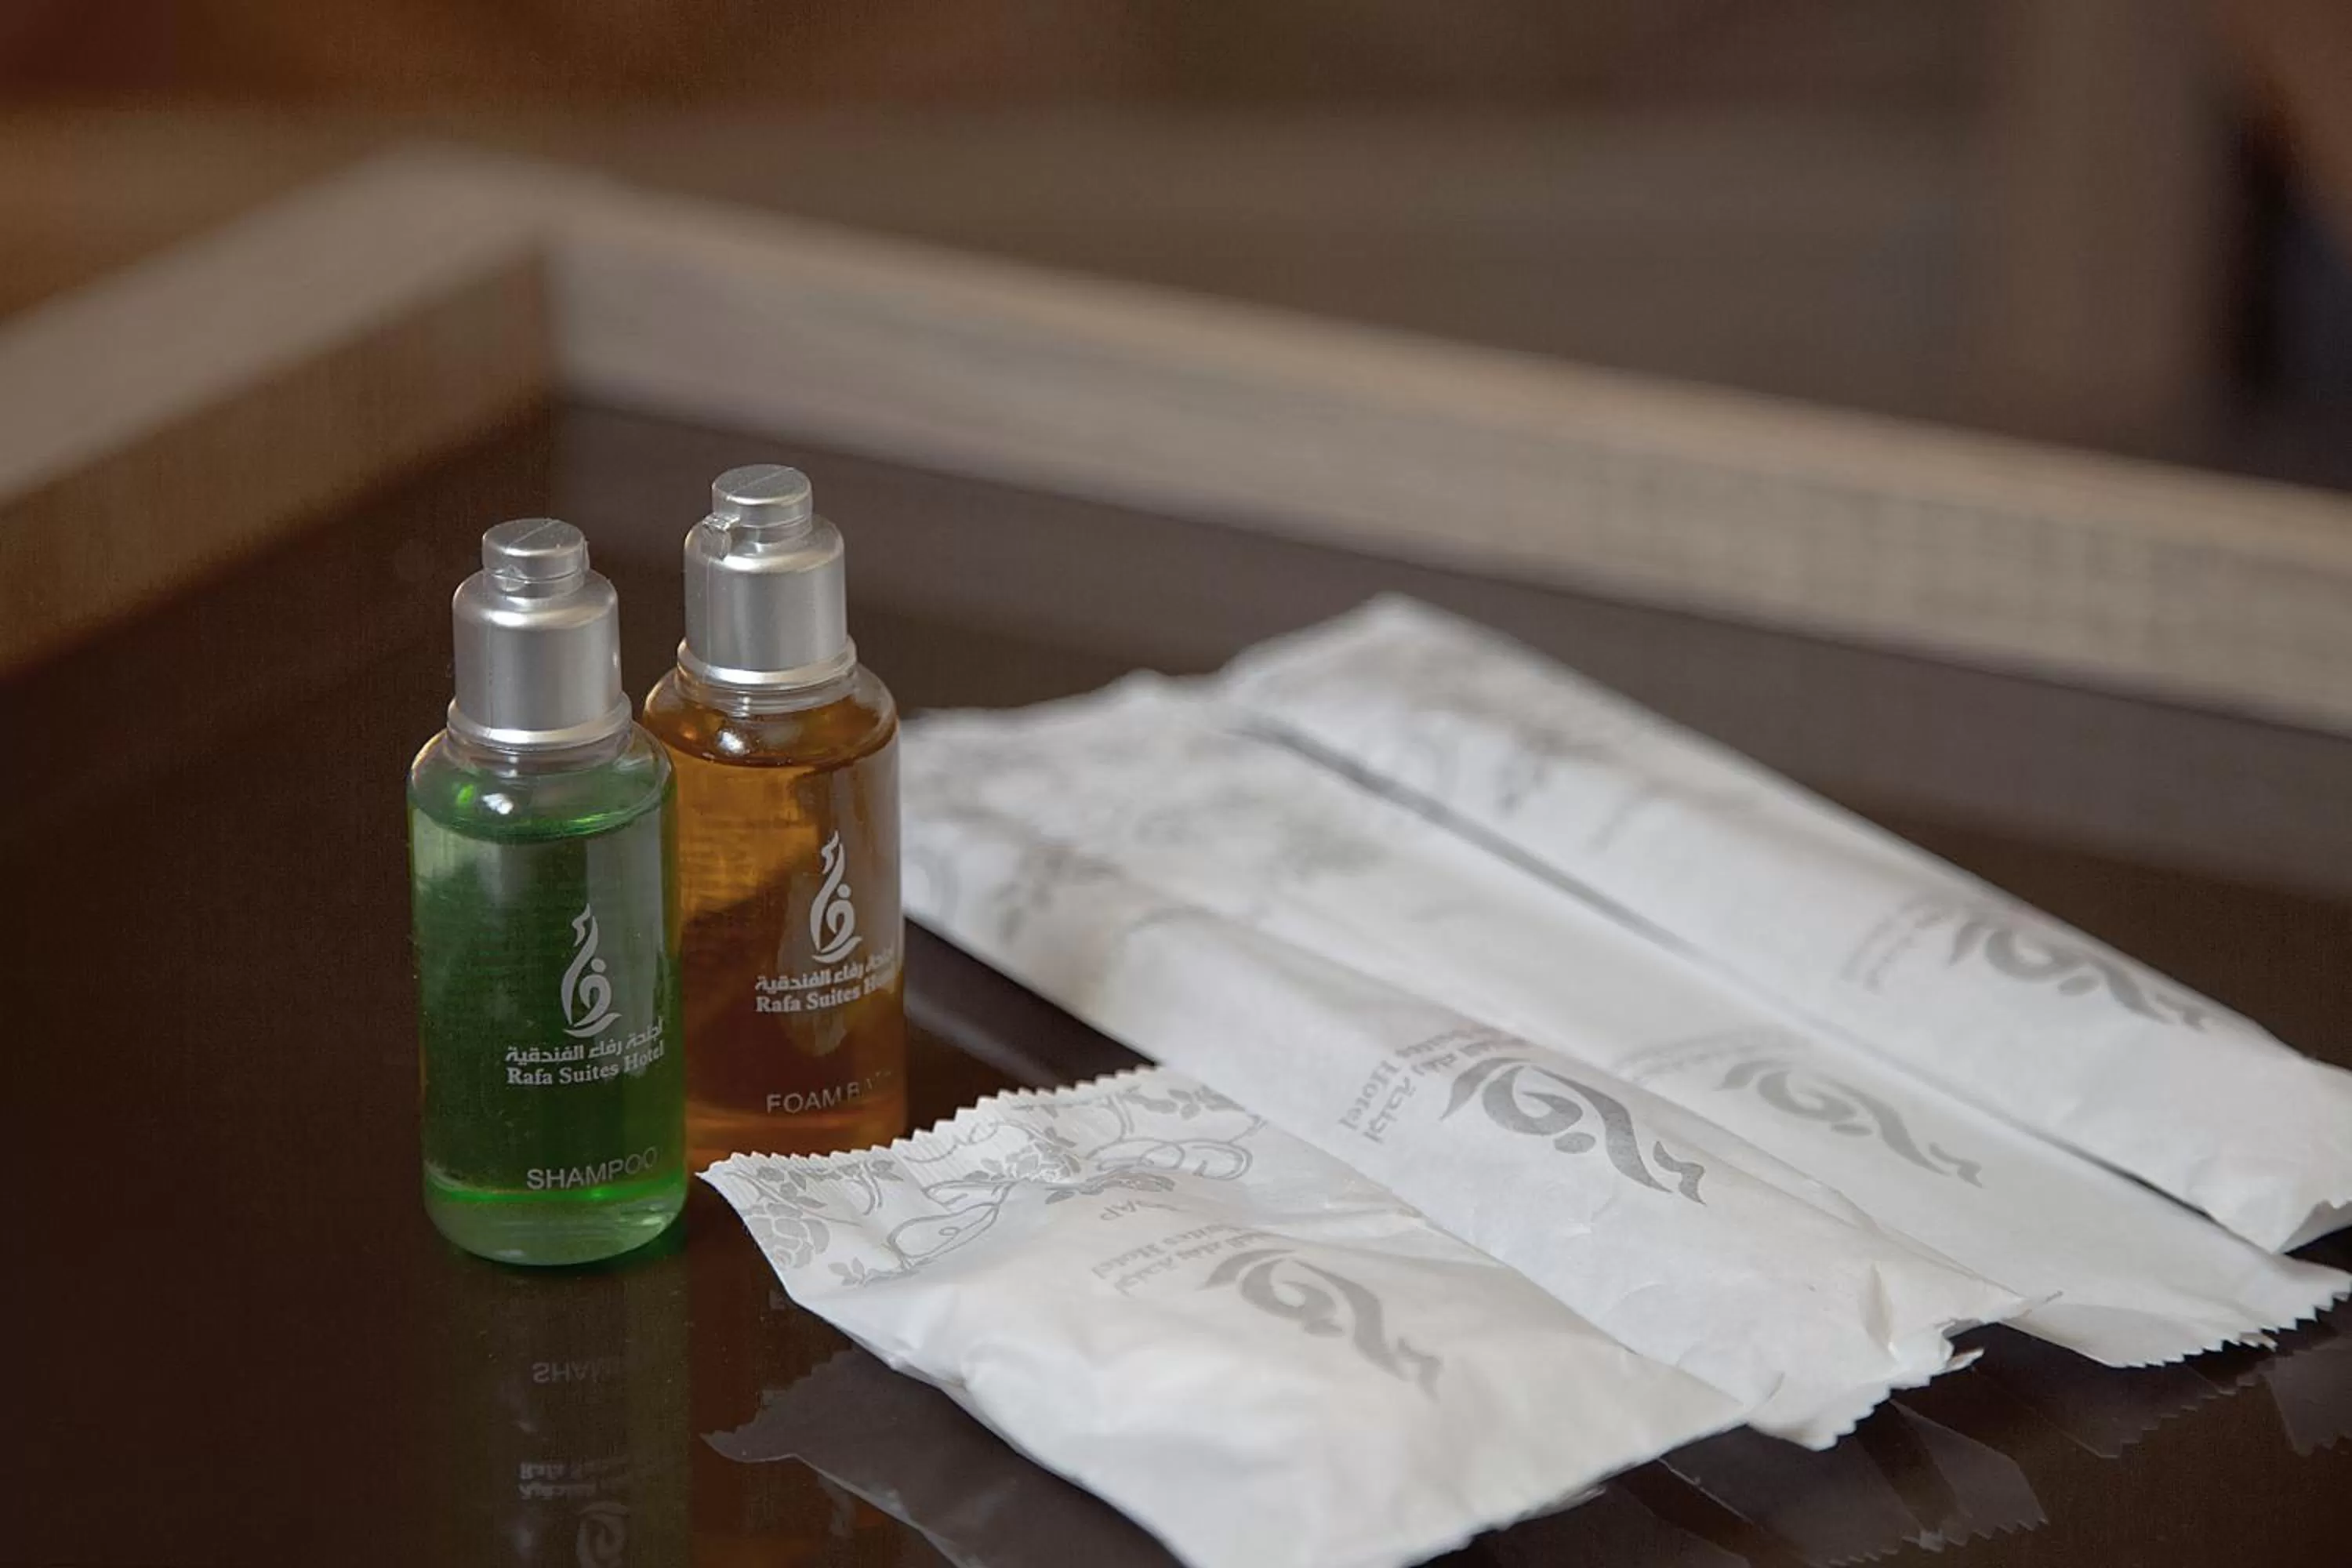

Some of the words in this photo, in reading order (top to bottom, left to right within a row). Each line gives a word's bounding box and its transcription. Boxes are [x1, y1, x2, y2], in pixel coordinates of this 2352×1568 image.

[755, 995, 802, 1013] Rafa
[805, 985, 862, 1011] Suites
[506, 1067, 554, 1086] Rafa
[558, 1062, 620, 1084] Suites
[623, 1040, 665, 1073] Hotel
[766, 1085, 843, 1115] FOAM
[526, 1145, 659, 1190] SHAMPOO
